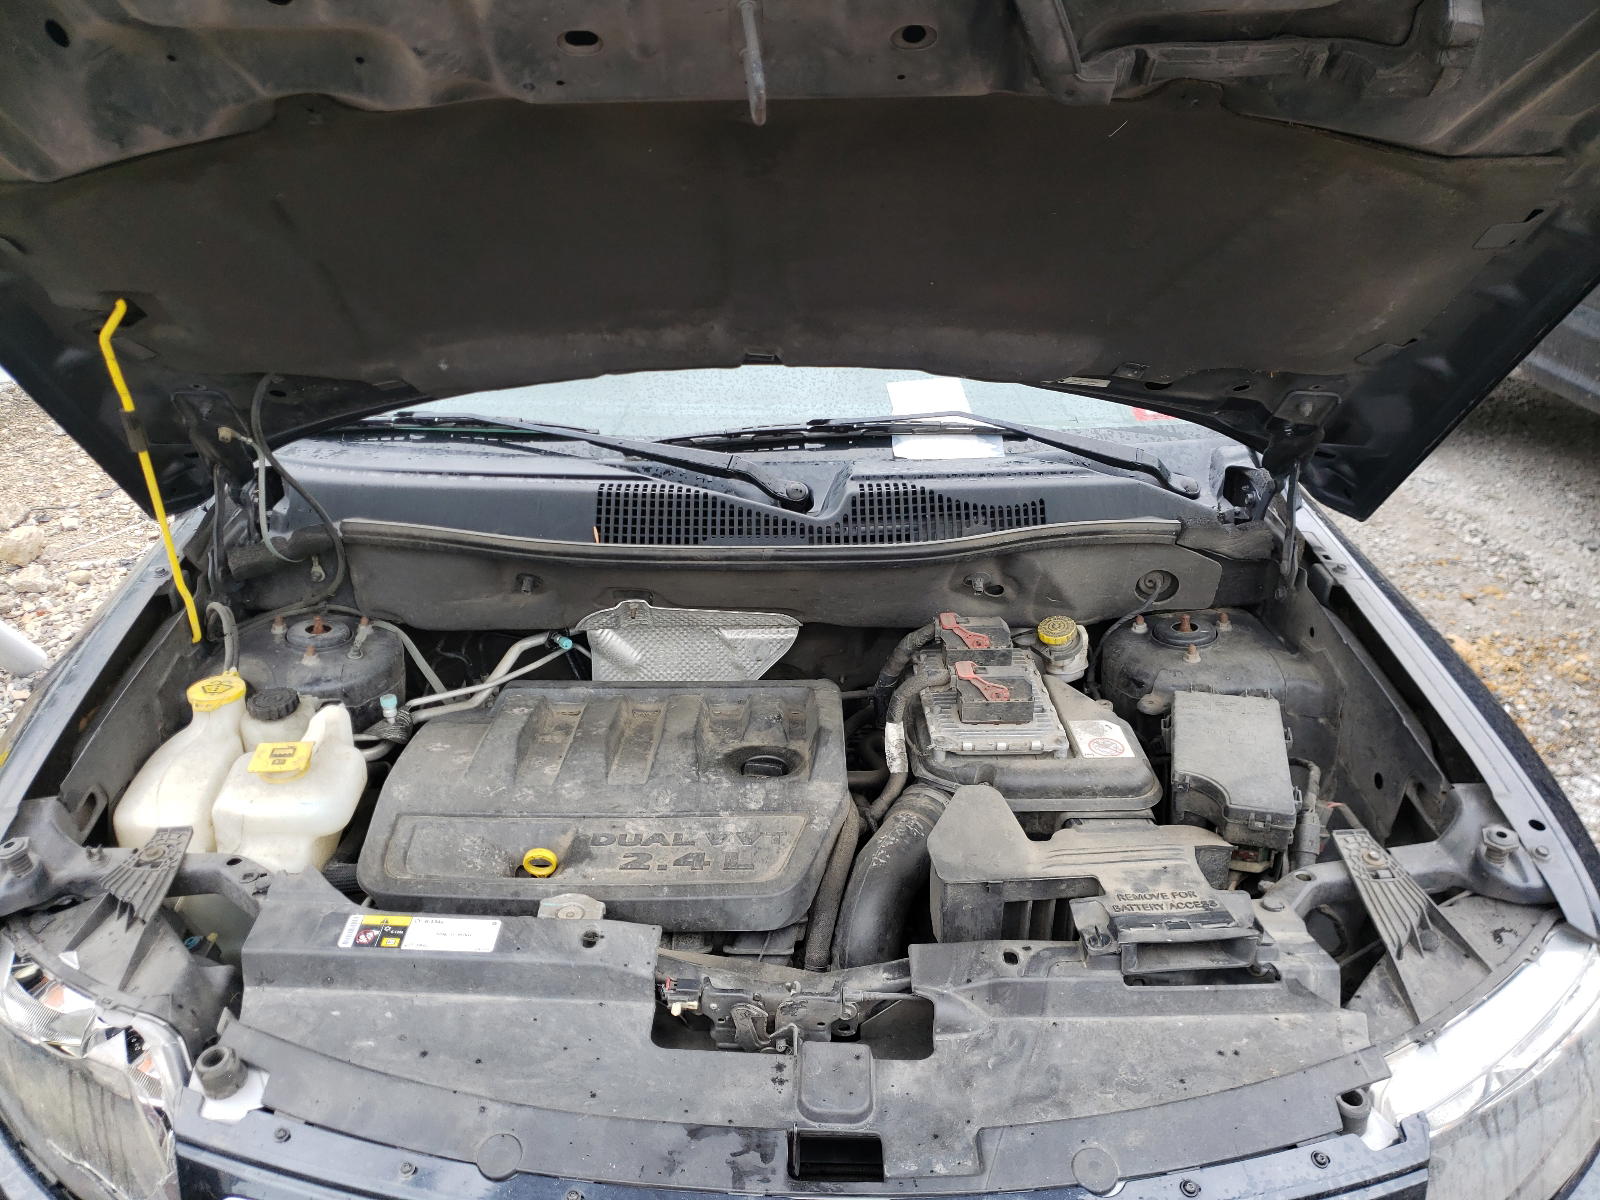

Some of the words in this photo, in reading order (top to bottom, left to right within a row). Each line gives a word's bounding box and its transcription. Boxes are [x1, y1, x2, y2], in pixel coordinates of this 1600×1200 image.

[590, 832, 696, 847] DUAL
[1116, 891, 1169, 902] REMOVE
[1171, 890, 1198, 900] FOR
[1112, 902, 1164, 913] BATTERY
[1168, 900, 1219, 911] ACCESS
